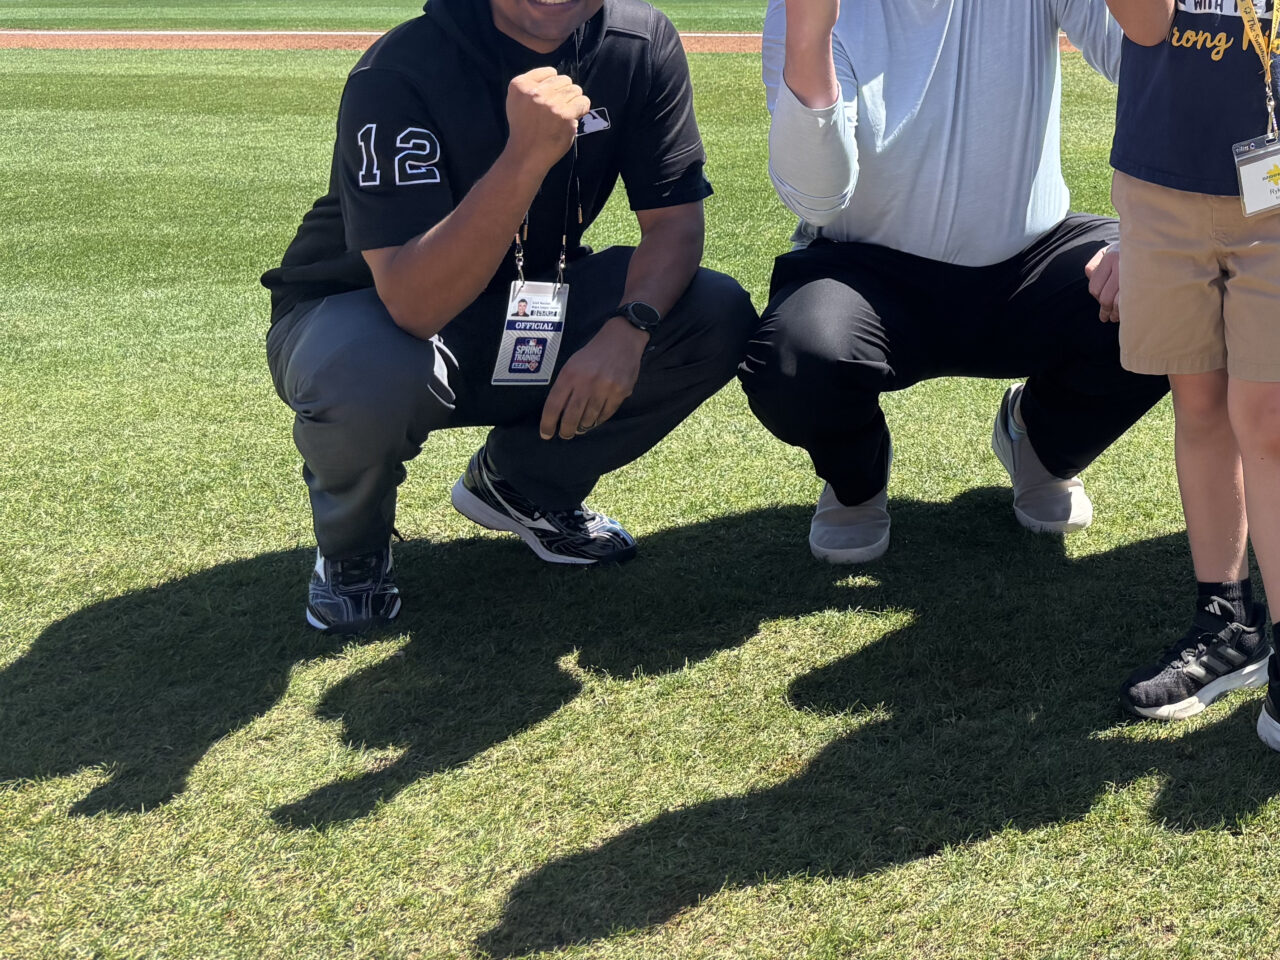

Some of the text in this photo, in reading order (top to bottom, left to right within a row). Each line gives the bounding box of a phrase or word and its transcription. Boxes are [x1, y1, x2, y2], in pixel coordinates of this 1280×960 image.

[1247, 16, 1257, 32] The
[1166, 26, 1234, 61] rong
[357, 123, 441, 187] 12
[515, 321, 554, 330] OFFICIAL
[515, 345, 543, 355] SPRING
[514, 353, 541, 362] TRAINING
